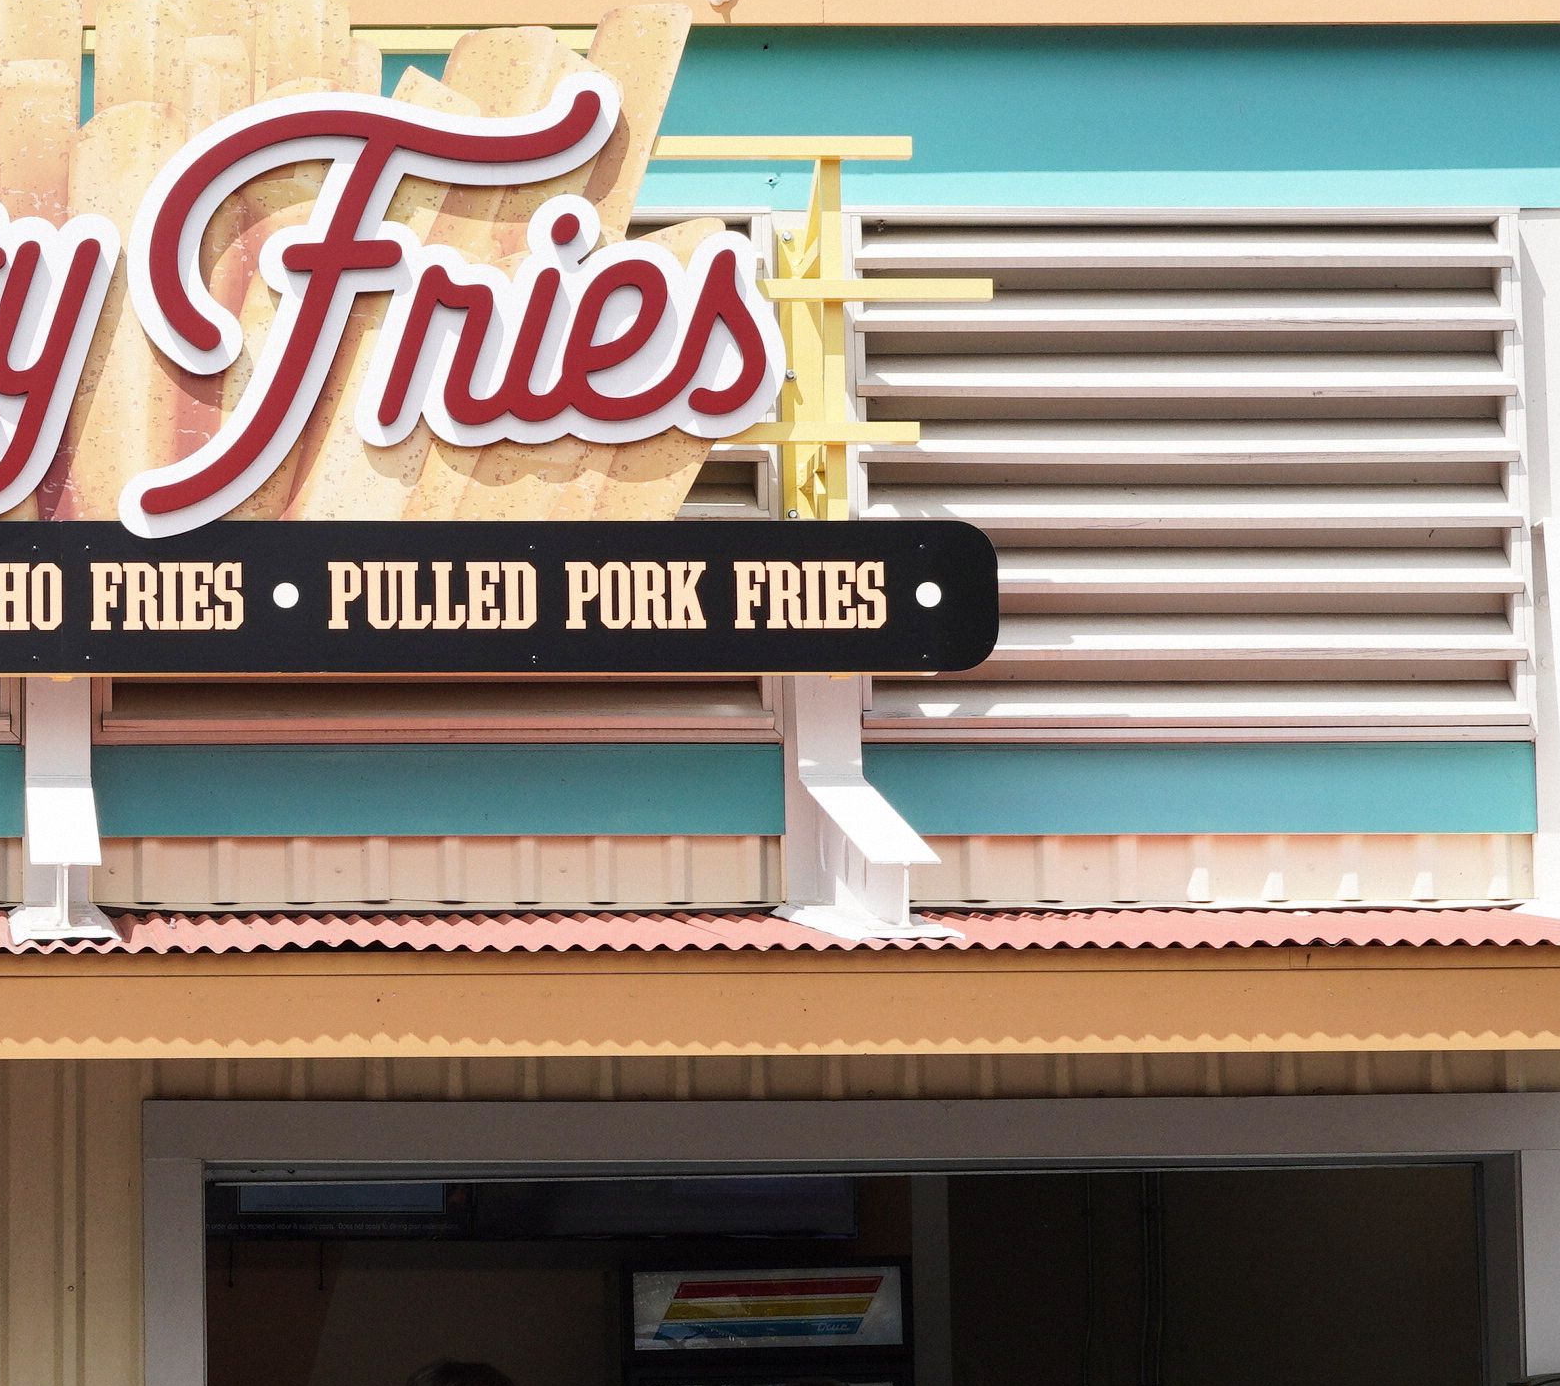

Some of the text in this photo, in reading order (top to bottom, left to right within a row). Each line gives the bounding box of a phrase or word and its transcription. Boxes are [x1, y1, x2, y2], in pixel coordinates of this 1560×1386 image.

[135, 78, 782, 527] Fries
[90, 561, 246, 633] FRIES
[327, 561, 539, 631] PULLED
[565, 560, 710, 631] PORK
[736, 560, 889, 630] FRIES
